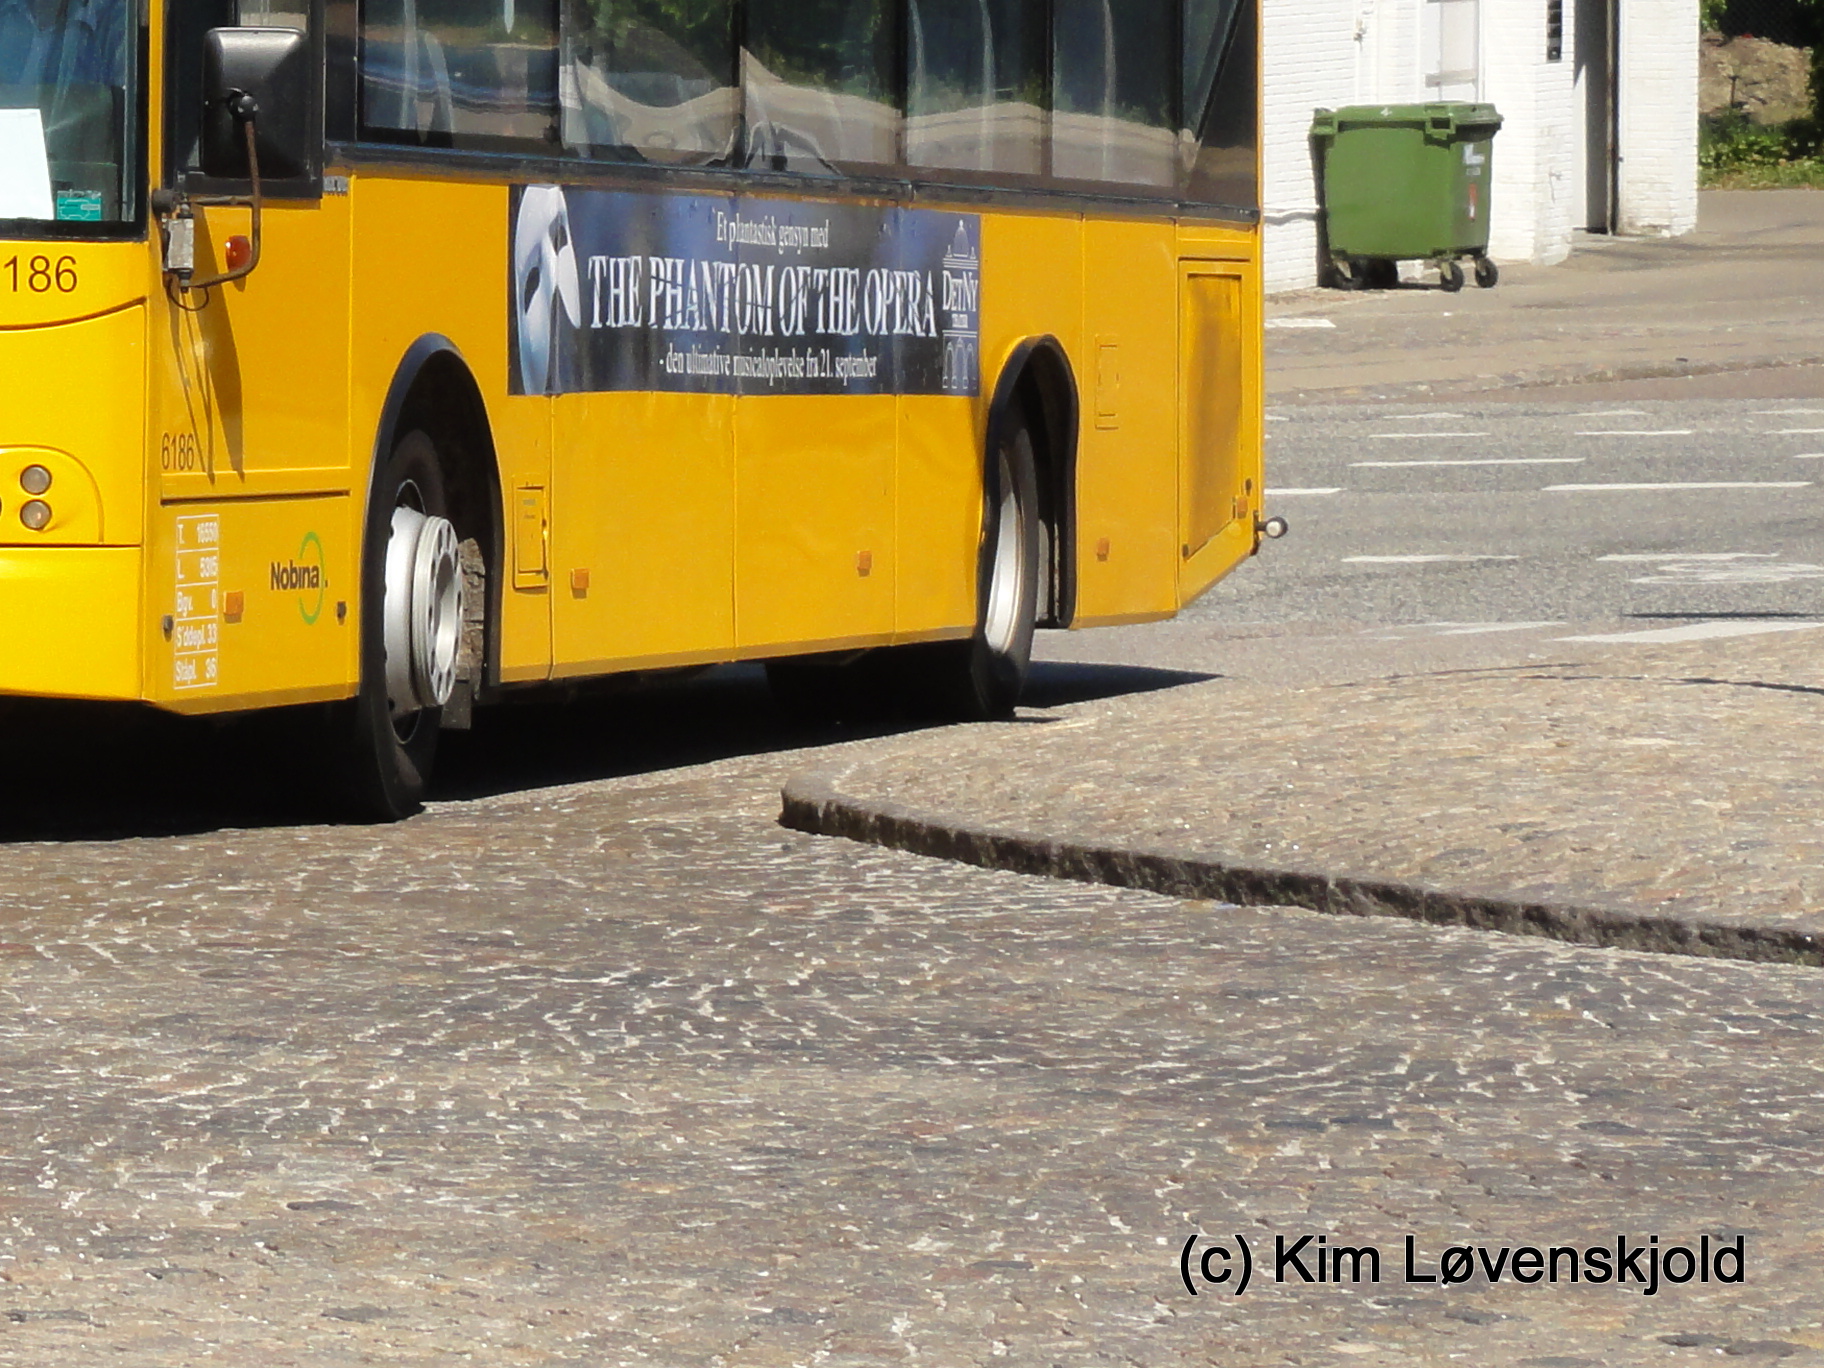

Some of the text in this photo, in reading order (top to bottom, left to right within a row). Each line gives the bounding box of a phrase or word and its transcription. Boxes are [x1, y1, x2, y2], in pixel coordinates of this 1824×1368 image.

[811, 219, 829, 248] med
[588, 256, 938, 338] THE PHANTOM OF THE OPERA
[666, 342, 684, 374] den
[806, 346, 819, 378] fra
[835, 347, 877, 387] september
[161, 432, 195, 471] 6186
[270, 559, 320, 591] Nobina
